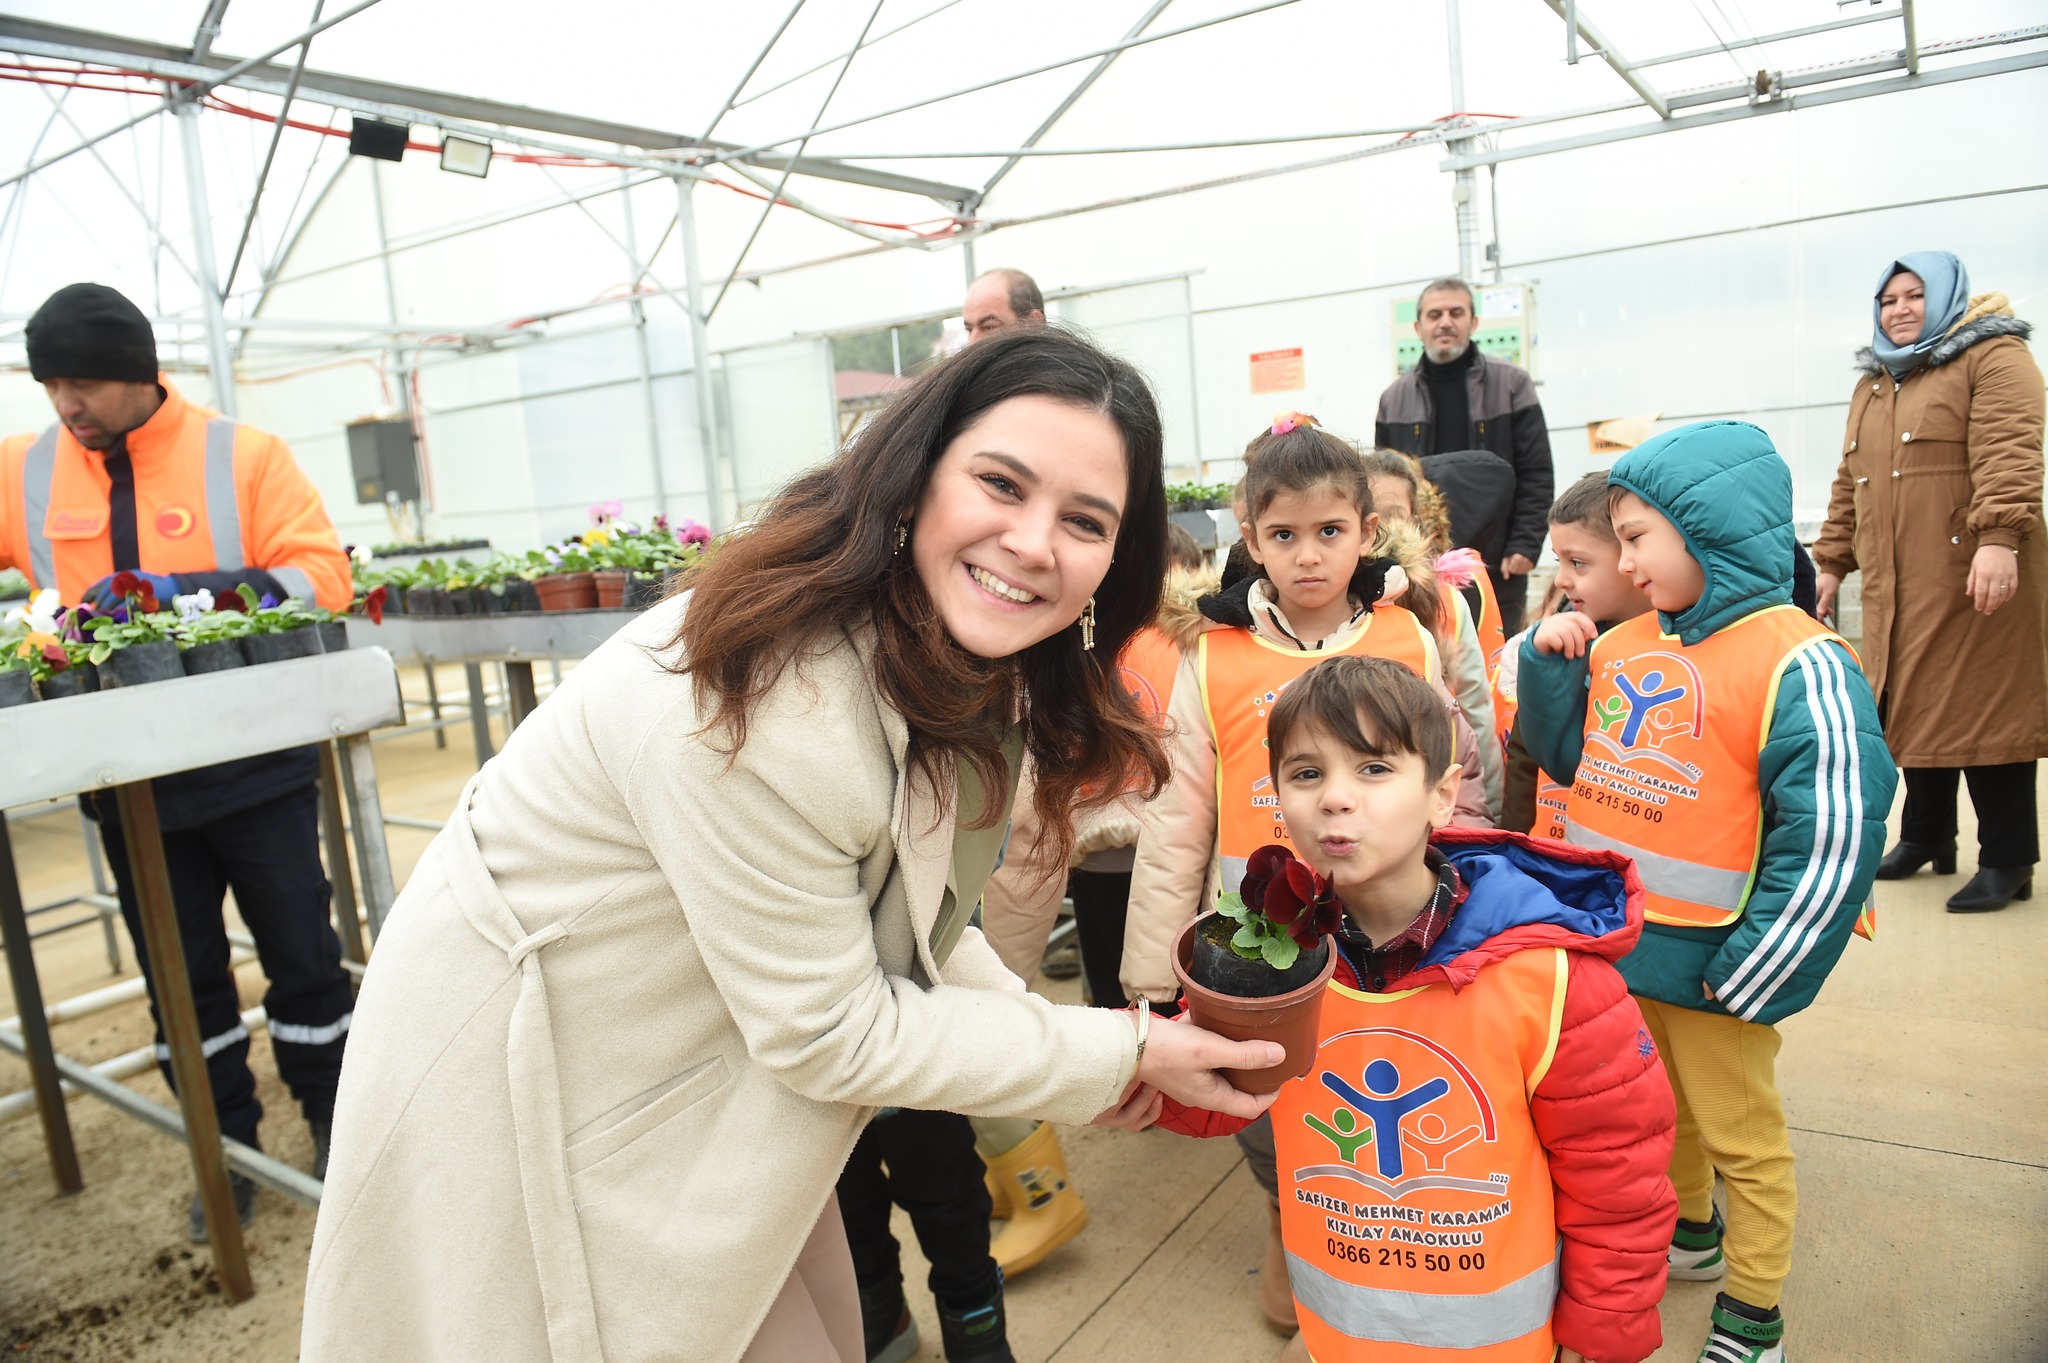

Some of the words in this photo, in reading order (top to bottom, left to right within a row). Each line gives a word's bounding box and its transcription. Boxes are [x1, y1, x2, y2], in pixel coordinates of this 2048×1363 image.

[1593, 759, 1636, 779] MEHMET
[1638, 774, 1698, 798] KARAMAN
[1609, 781, 1666, 805] ANAOKULU
[1253, 796, 1281, 806] SAFİZ
[1538, 797, 1567, 811] SAFİZE
[1573, 783, 1592, 800] 366
[1596, 792, 1620, 809] 215
[1622, 801, 1640, 816] 50
[1644, 808, 1663, 823] 00
[1490, 1174, 1509, 1184] 2023
[1296, 1190, 1349, 1215] SAFİZER
[1355, 1205, 1424, 1223] MEHMET
[1431, 1201, 1510, 1225] KARAMAN
[1327, 1217, 1383, 1239] KIZILAY
[1390, 1227, 1483, 1246] ANAOKULU
[1328, 1238, 1371, 1264] 0366
[1379, 1249, 1417, 1269] 215
[1425, 1254, 1450, 1272] 50
[1459, 1253, 1485, 1270] 00
